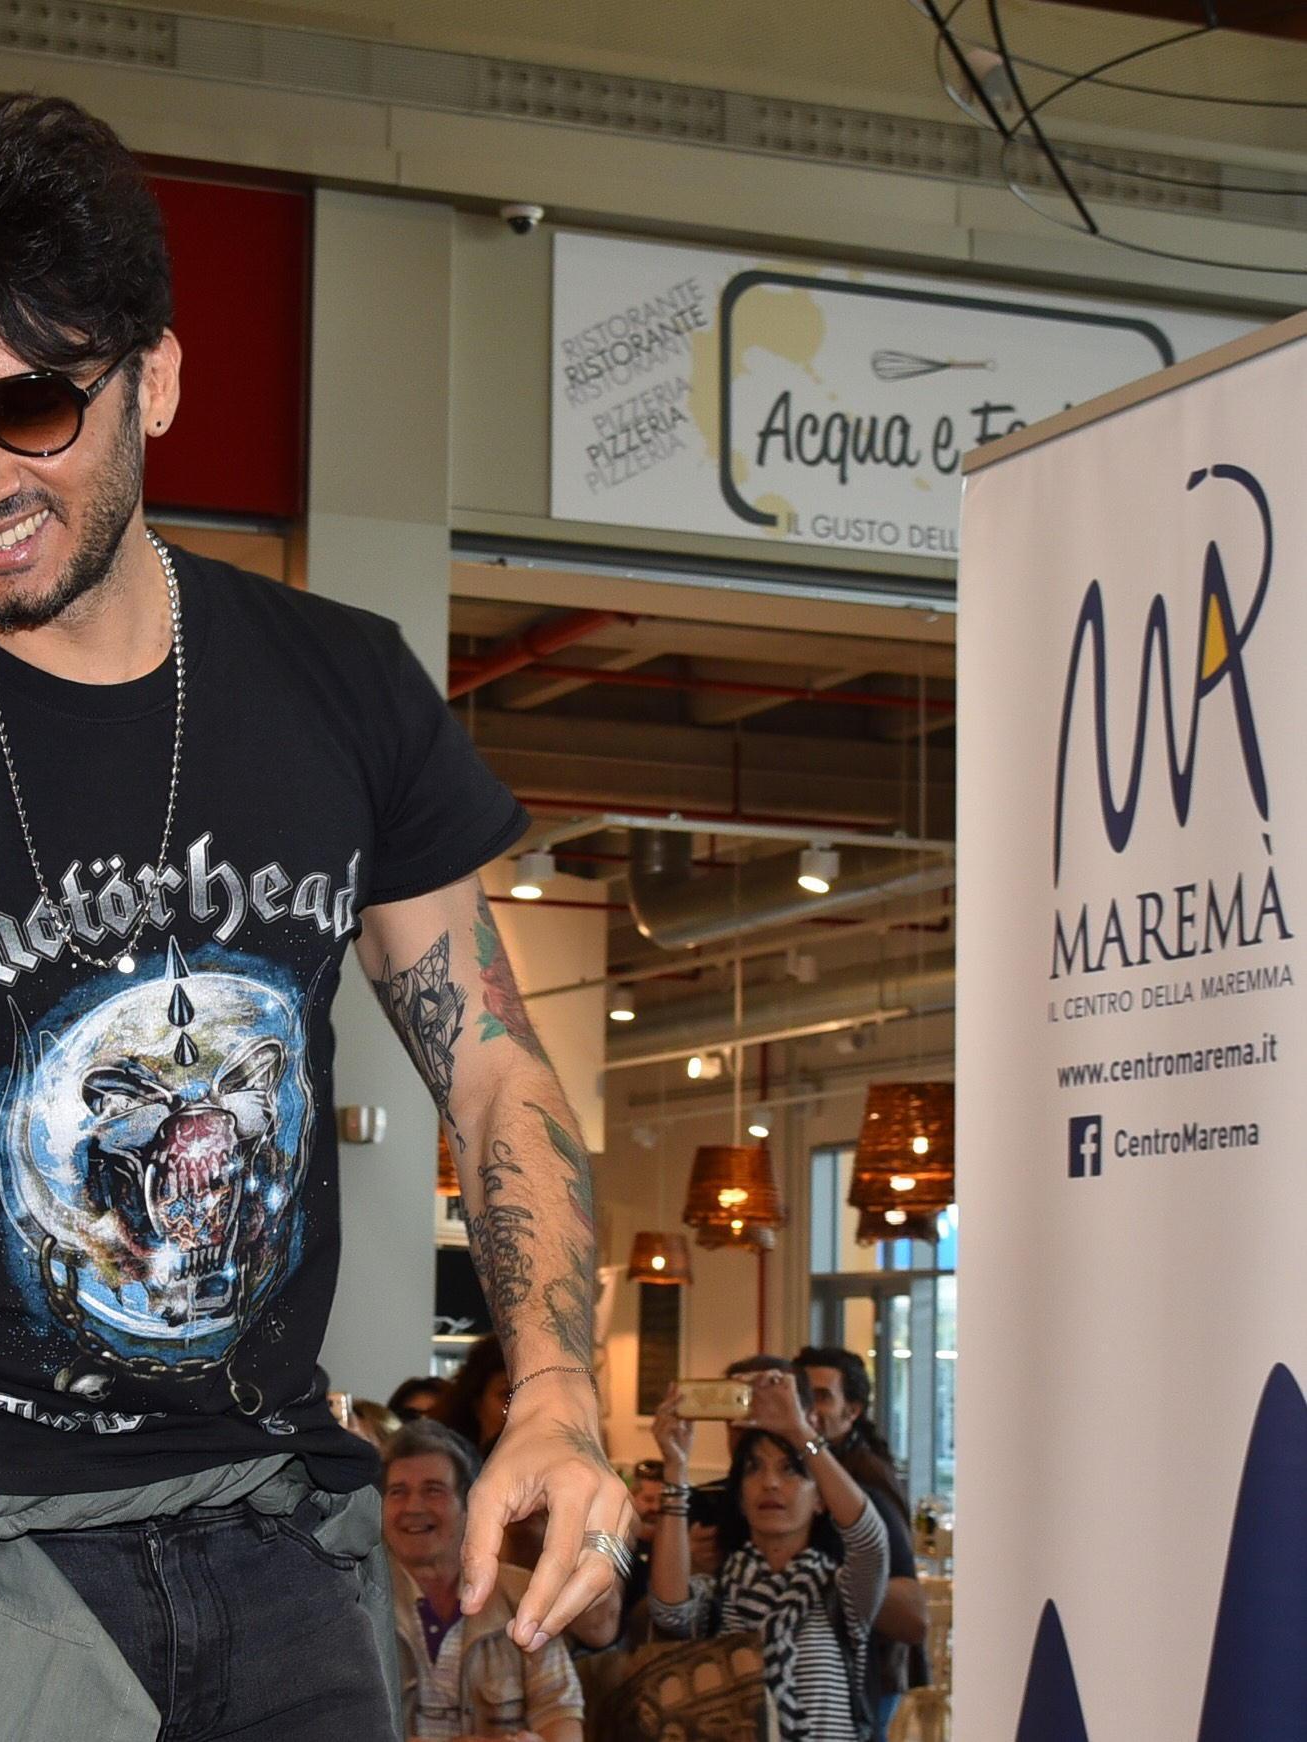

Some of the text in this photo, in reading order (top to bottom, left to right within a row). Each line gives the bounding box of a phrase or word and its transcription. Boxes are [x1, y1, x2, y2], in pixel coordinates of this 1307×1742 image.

[564, 304, 709, 384] RISTORANTE
[586, 406, 689, 466] PIZZERIA
[756, 391, 920, 485] Acqua
[933, 415, 959, 474] e
[811, 514, 900, 546] GUSTO
[1049, 832, 1295, 980] MAREMÀ
[1047, 964, 1295, 1023] IL CENTRO DELLA MAREMMA
[1057, 1033, 1278, 1088] www.centromarema.it
[1114, 1122, 1260, 1159] CentroMarema
